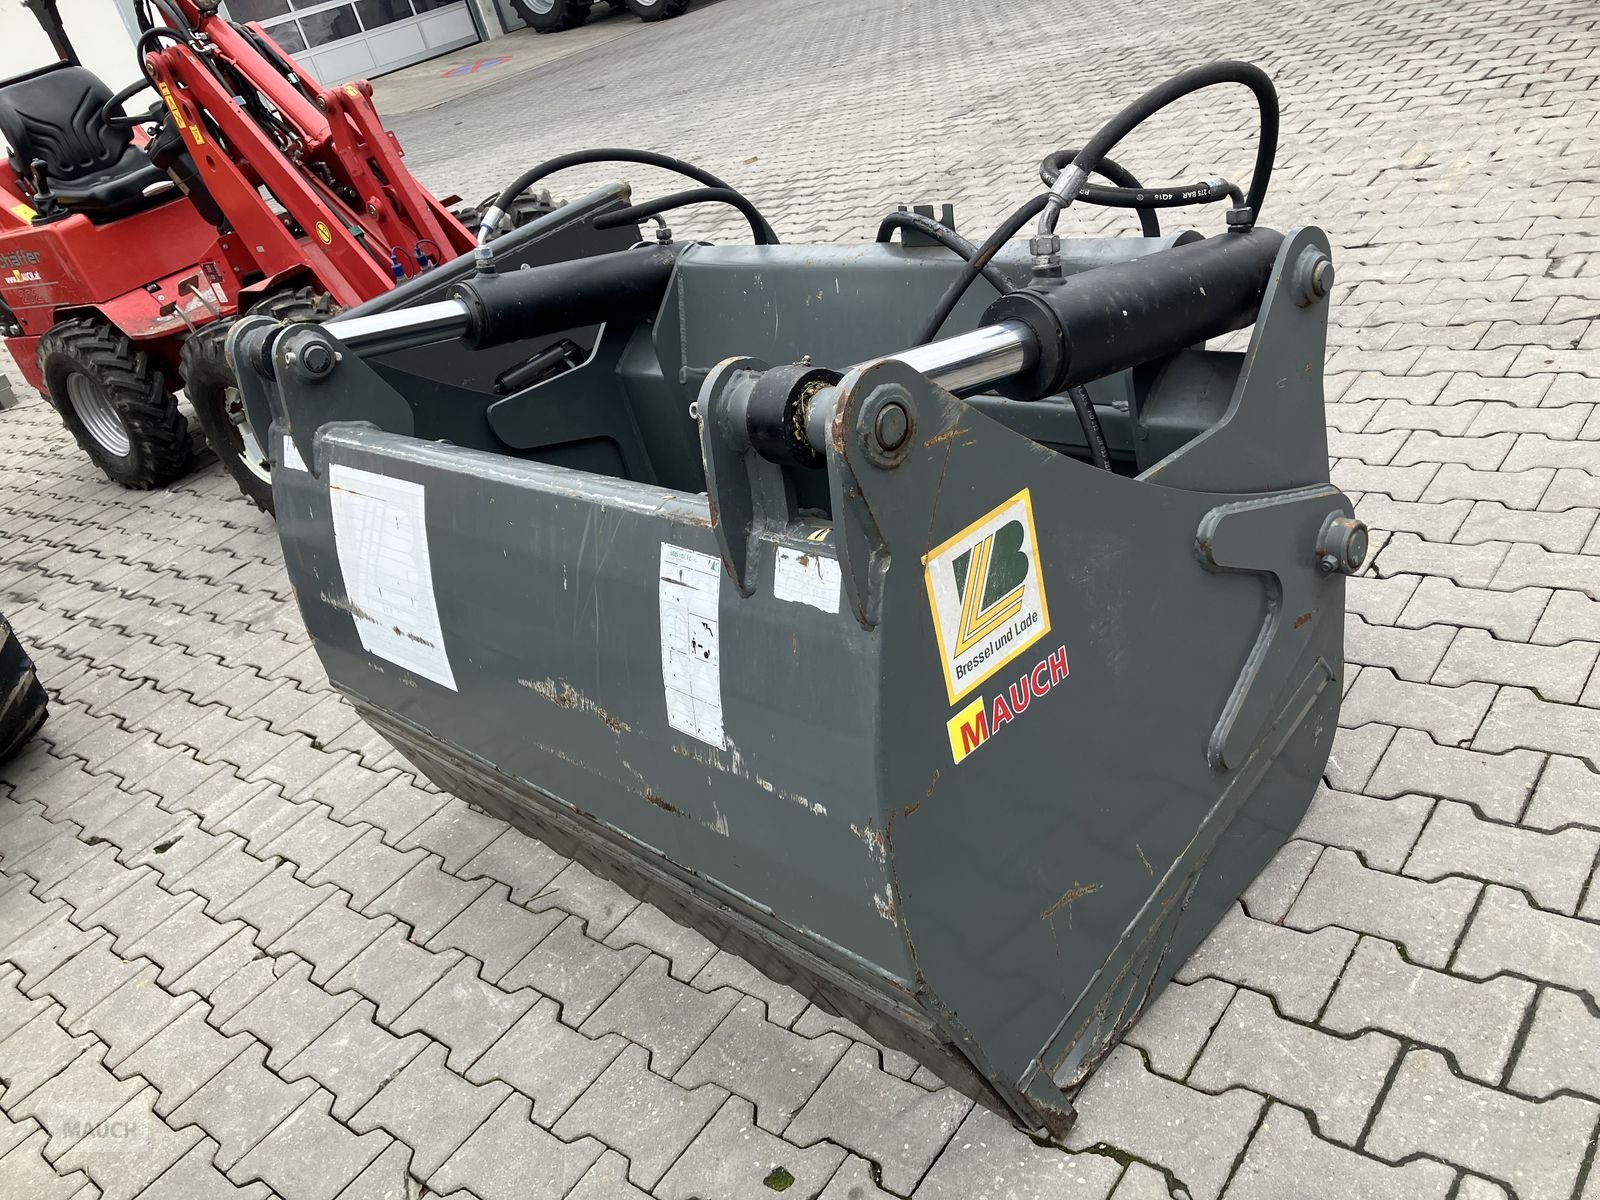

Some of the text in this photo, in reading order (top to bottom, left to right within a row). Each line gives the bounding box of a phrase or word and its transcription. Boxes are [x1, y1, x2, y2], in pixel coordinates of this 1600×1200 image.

[1182, 190, 1197, 199] BAR
[0, 249, 40, 269] chäffer
[955, 611, 1039, 680] Bressel und Lade
[959, 645, 1070, 756] MAUCH
